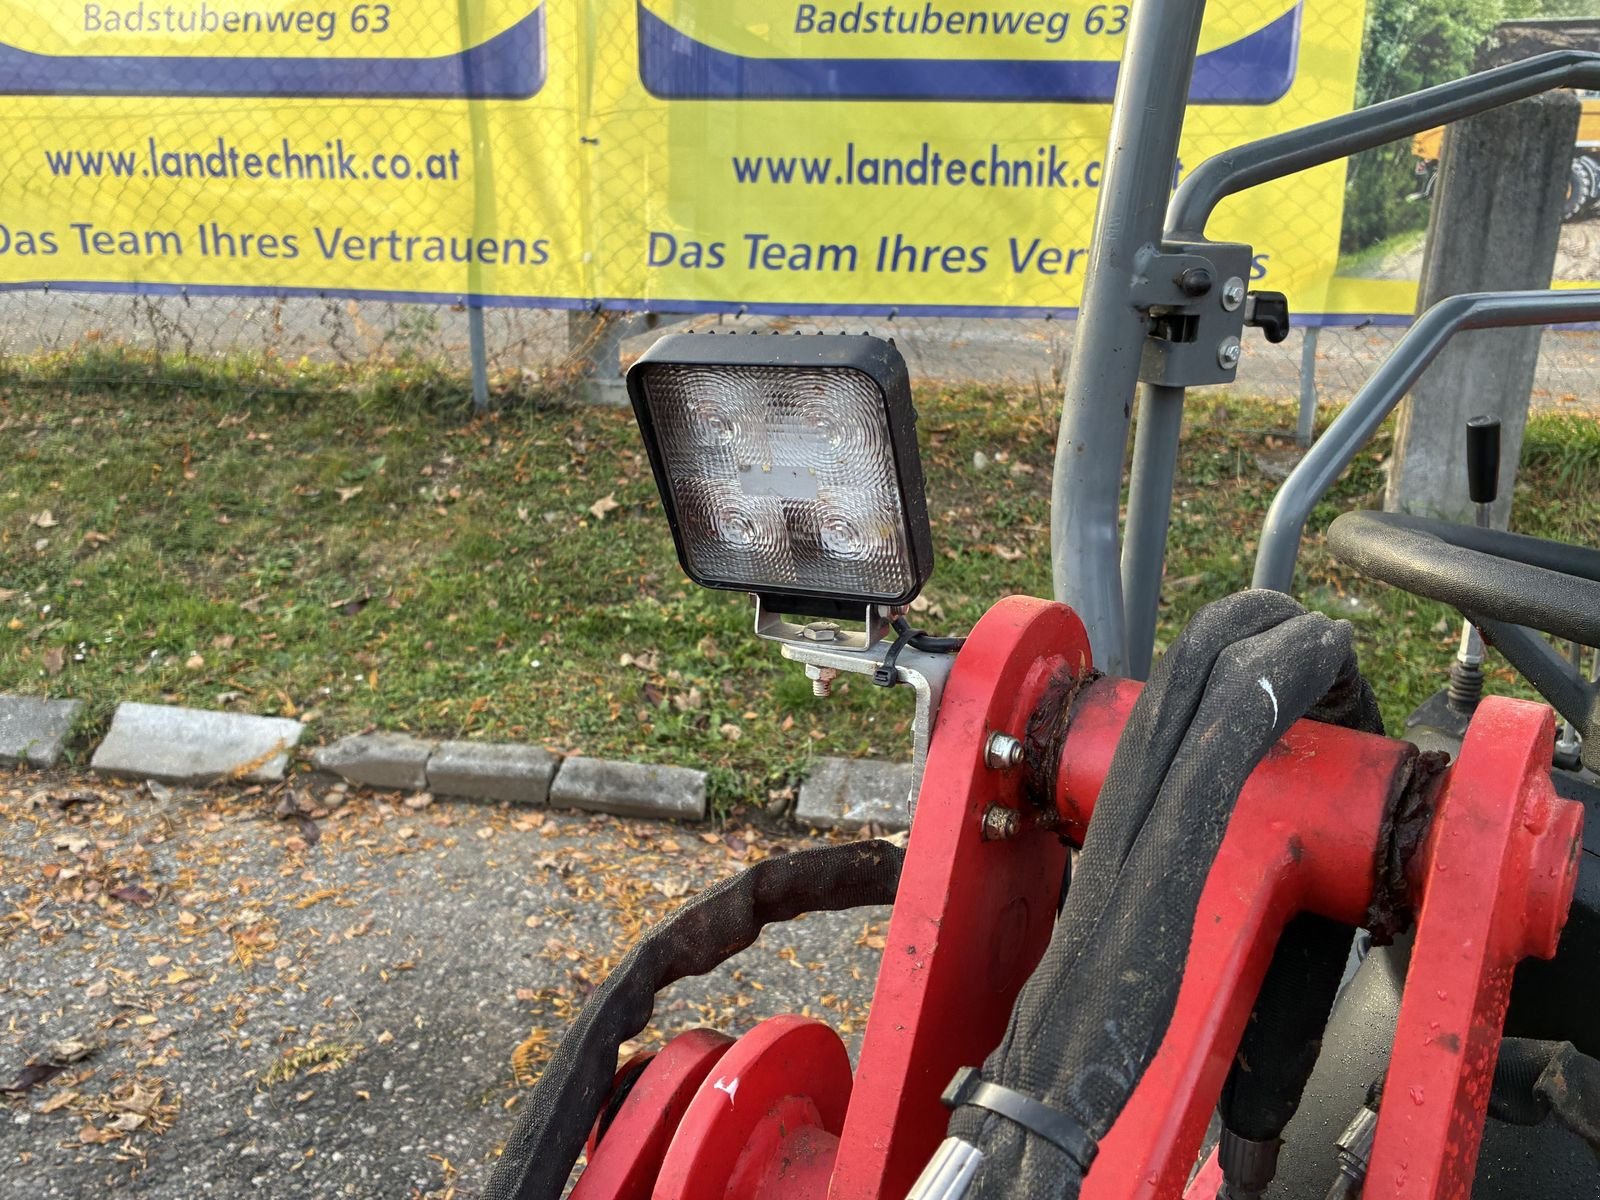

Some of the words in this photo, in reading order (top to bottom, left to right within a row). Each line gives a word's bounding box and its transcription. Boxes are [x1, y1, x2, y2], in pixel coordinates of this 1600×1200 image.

[83, 3, 336, 40] Badstubenweg
[350, 4, 391, 33] 63
[794, 2, 1069, 42] Badstubenweg
[1085, 4, 1129, 35] 63
[45, 137, 461, 181] www.landtechnik.co.at
[732, 141, 1184, 190] www.landtechnik.ct
[70, 222, 183, 258] Team
[199, 223, 300, 259] Ihres
[314, 226, 550, 265] Vertrauens
[647, 231, 725, 268] Das
[743, 233, 858, 271] Team
[876, 235, 988, 273] Ihres
